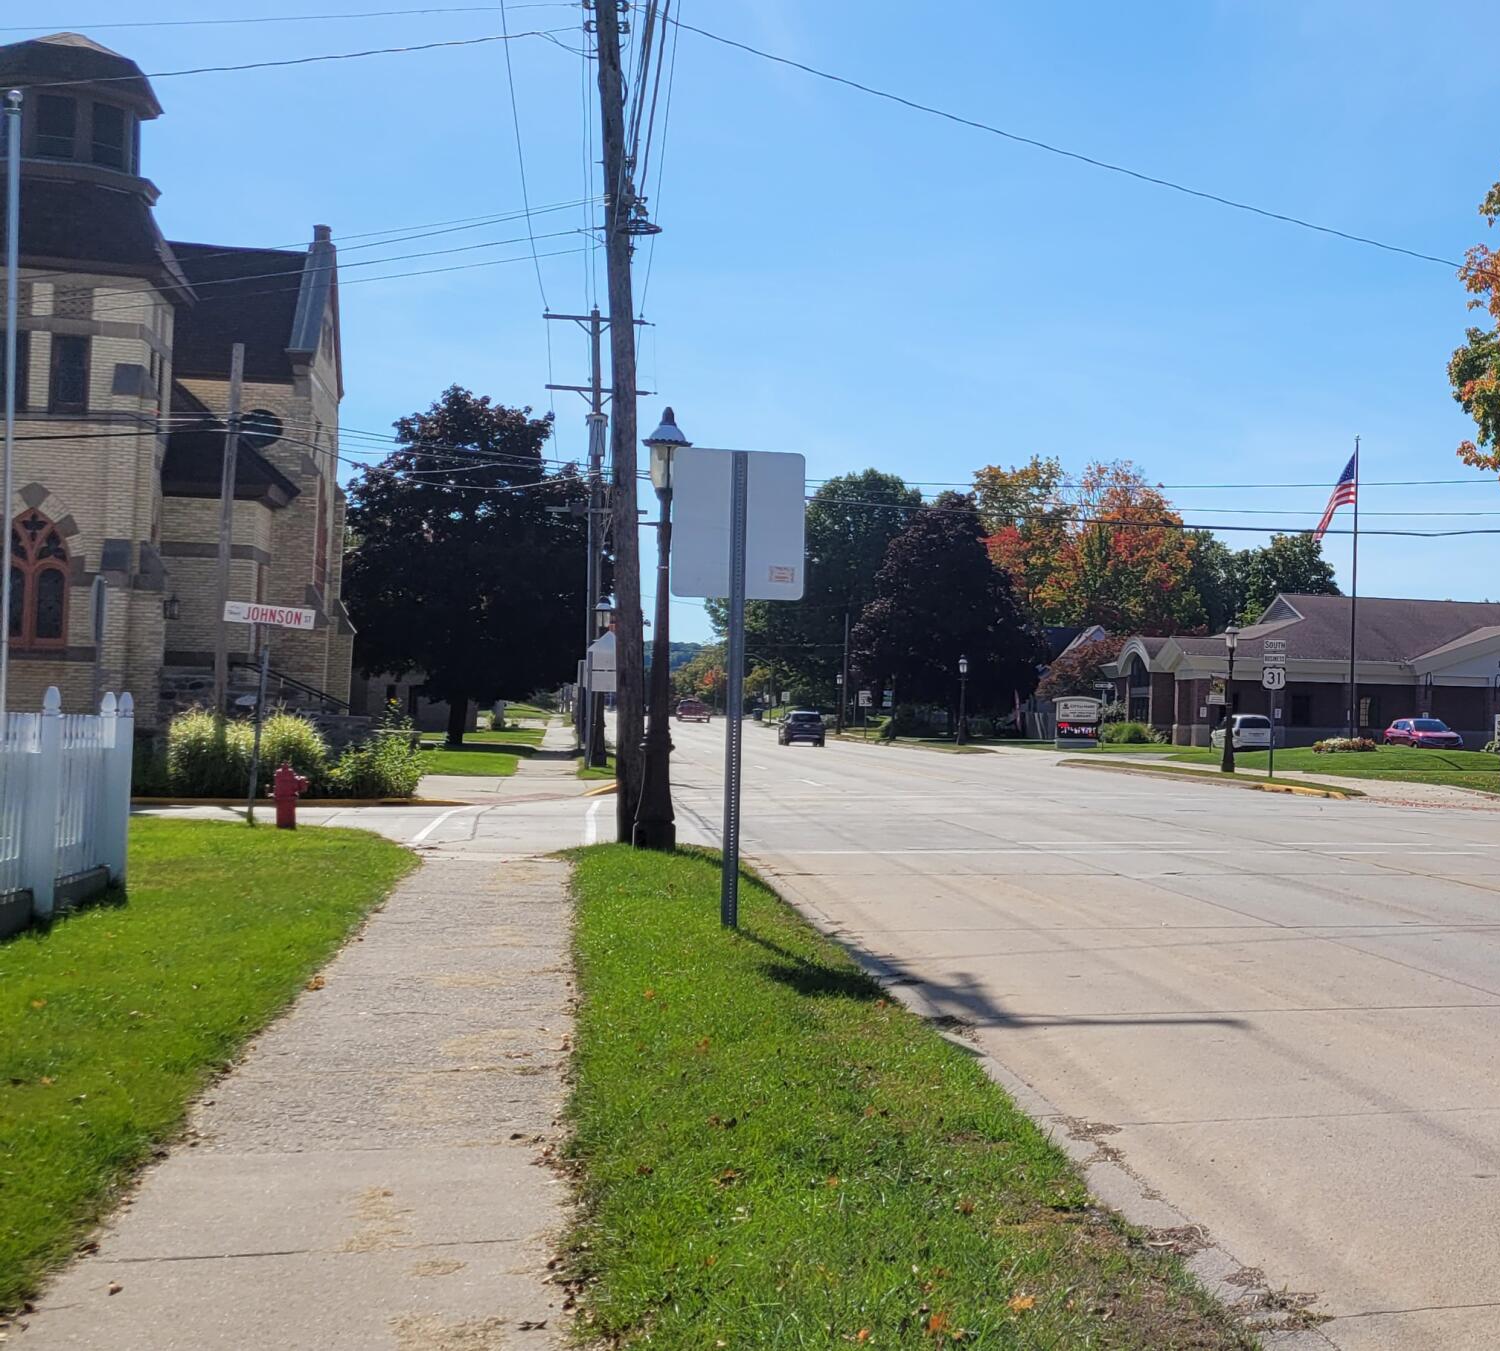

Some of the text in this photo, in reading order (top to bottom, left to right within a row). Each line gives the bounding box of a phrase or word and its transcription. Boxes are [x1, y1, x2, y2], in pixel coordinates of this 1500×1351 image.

[243, 607, 303, 625] JOHNSON
[1265, 640, 1286, 649] SOUTH
[1266, 671, 1281, 685] 31
